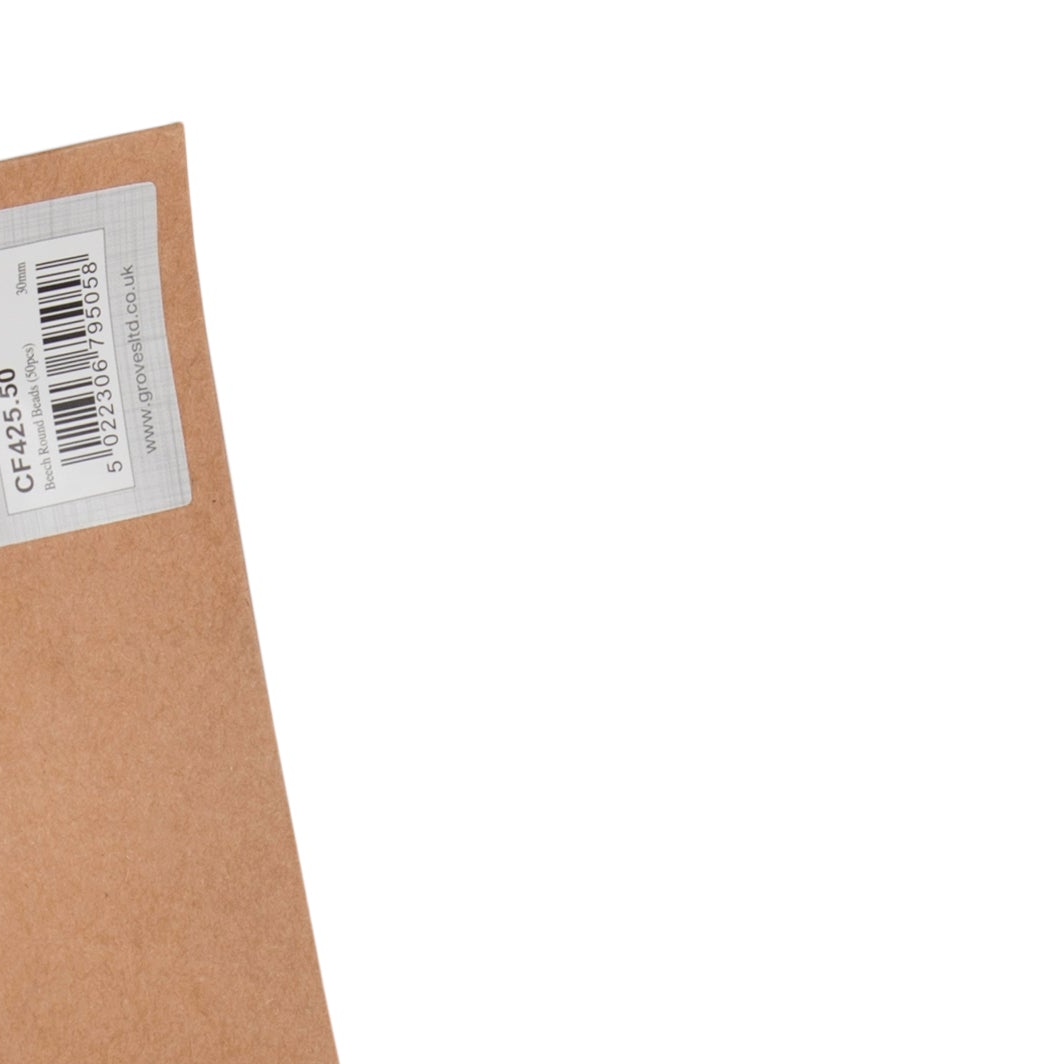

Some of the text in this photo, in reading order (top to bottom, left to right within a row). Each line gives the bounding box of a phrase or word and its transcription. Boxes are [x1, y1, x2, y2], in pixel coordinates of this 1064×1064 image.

[16, 262, 27, 295] 30mm
[120, 264, 157, 454] www.grovesltd.co.uk
[22, 343, 56, 491] Beech Round Beads (50pcs)
[107, 460, 123, 473] 5
